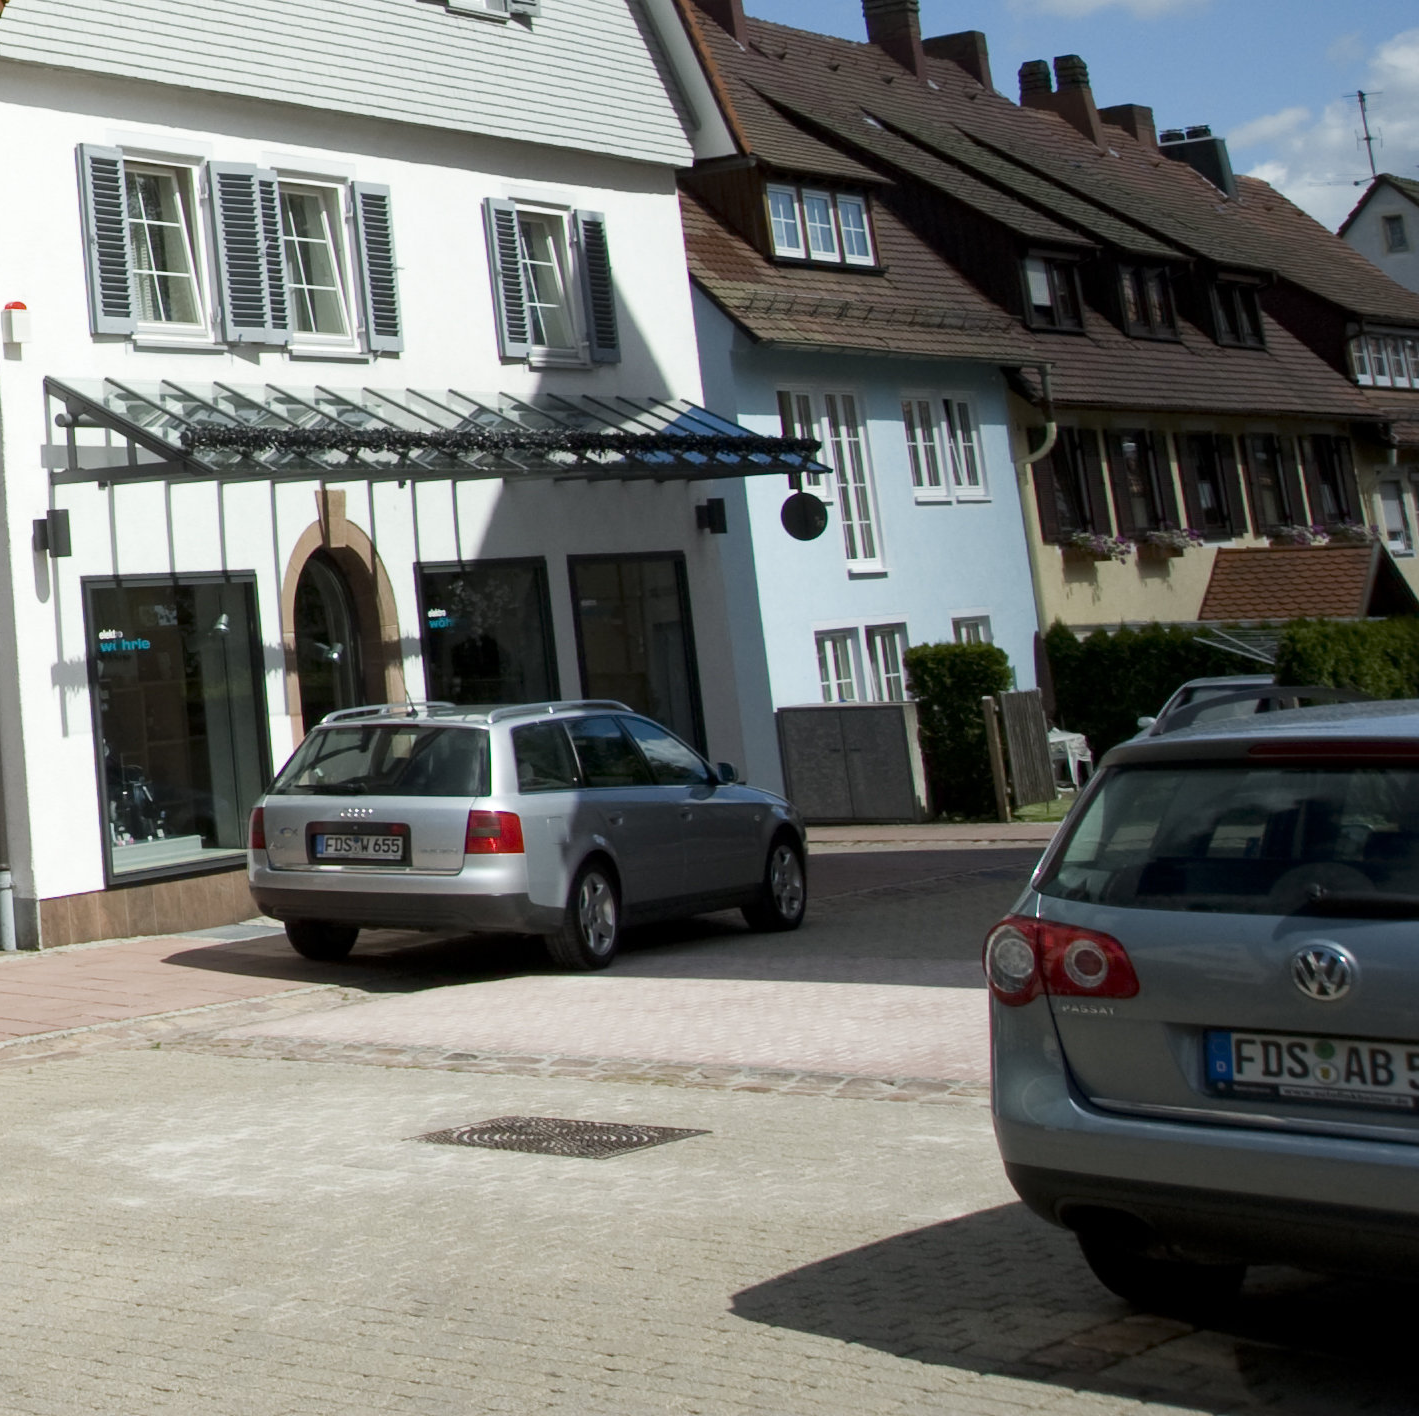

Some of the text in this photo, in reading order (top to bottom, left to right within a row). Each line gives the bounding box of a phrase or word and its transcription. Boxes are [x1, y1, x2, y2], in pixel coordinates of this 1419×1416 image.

[324, 837, 352, 853] FDS
[361, 838, 371, 853] W
[373, 838, 401, 854] 655
[1062, 1005, 1116, 1015] PASSAT
[1234, 1038, 1310, 1079] FDS
[1344, 1046, 1395, 1087] AB
